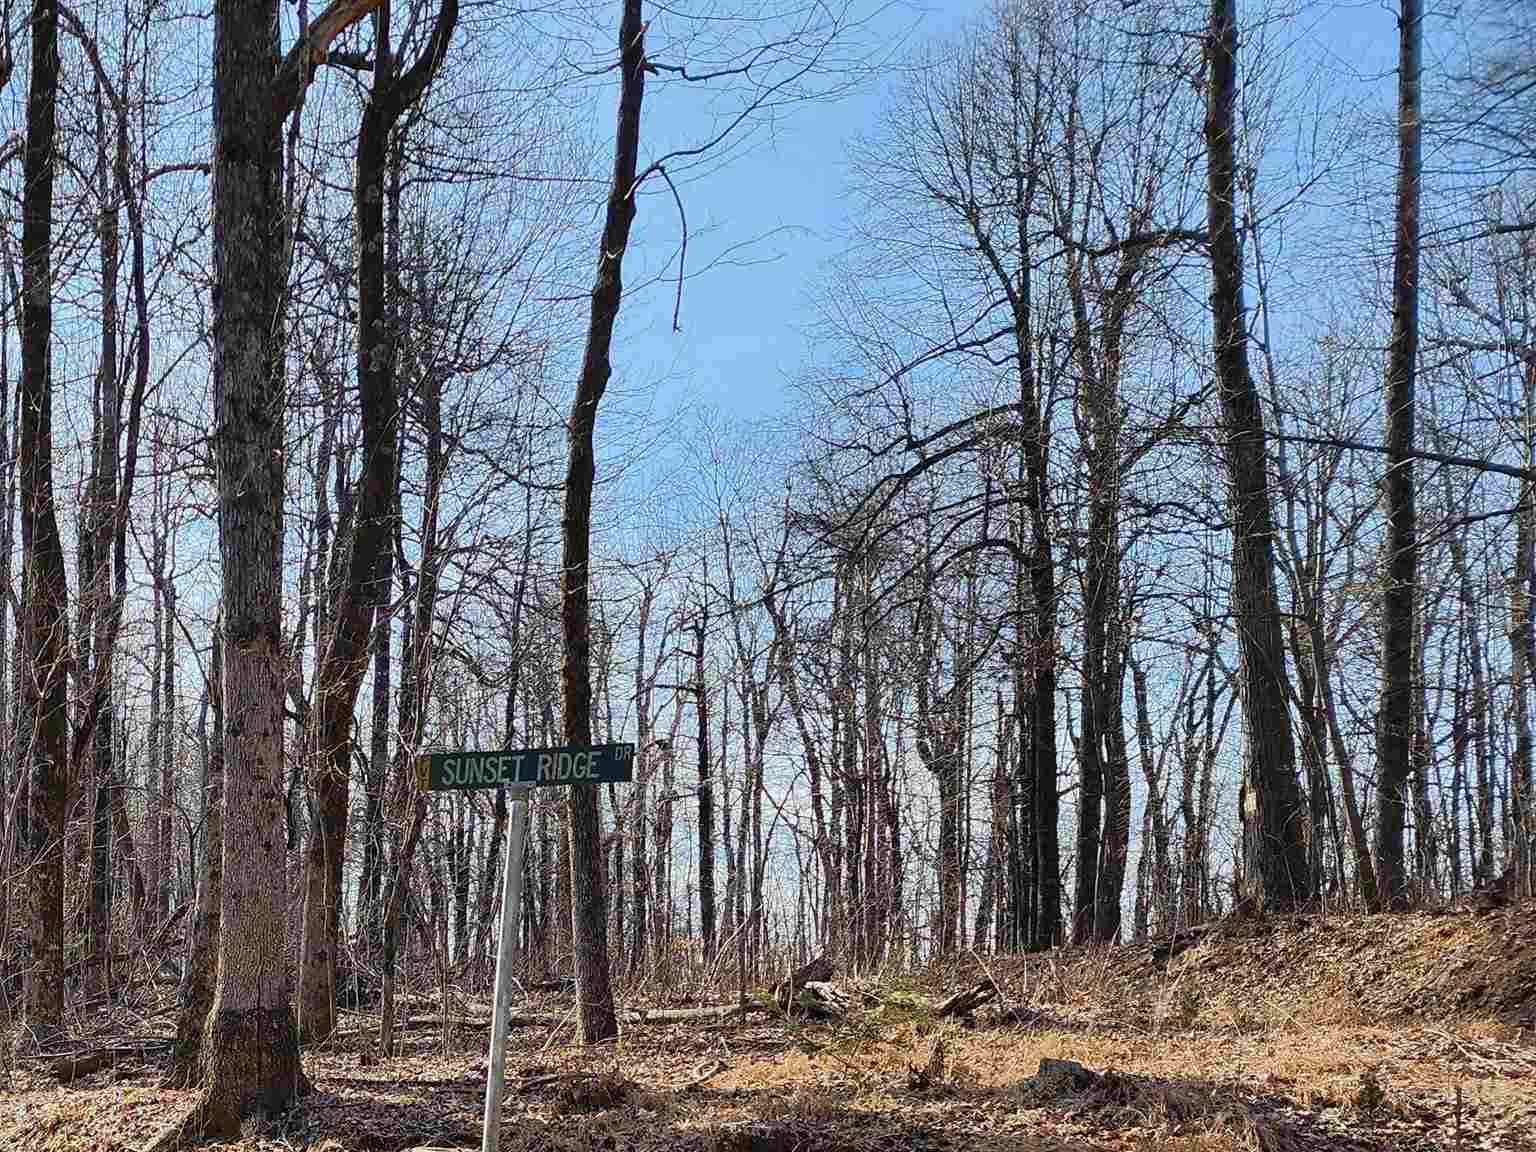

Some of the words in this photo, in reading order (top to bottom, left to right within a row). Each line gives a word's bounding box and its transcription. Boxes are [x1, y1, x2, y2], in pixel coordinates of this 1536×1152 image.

[441, 755, 526, 785] SUNSET
[536, 751, 601, 781] RIDGE
[615, 745, 632, 761] DR
